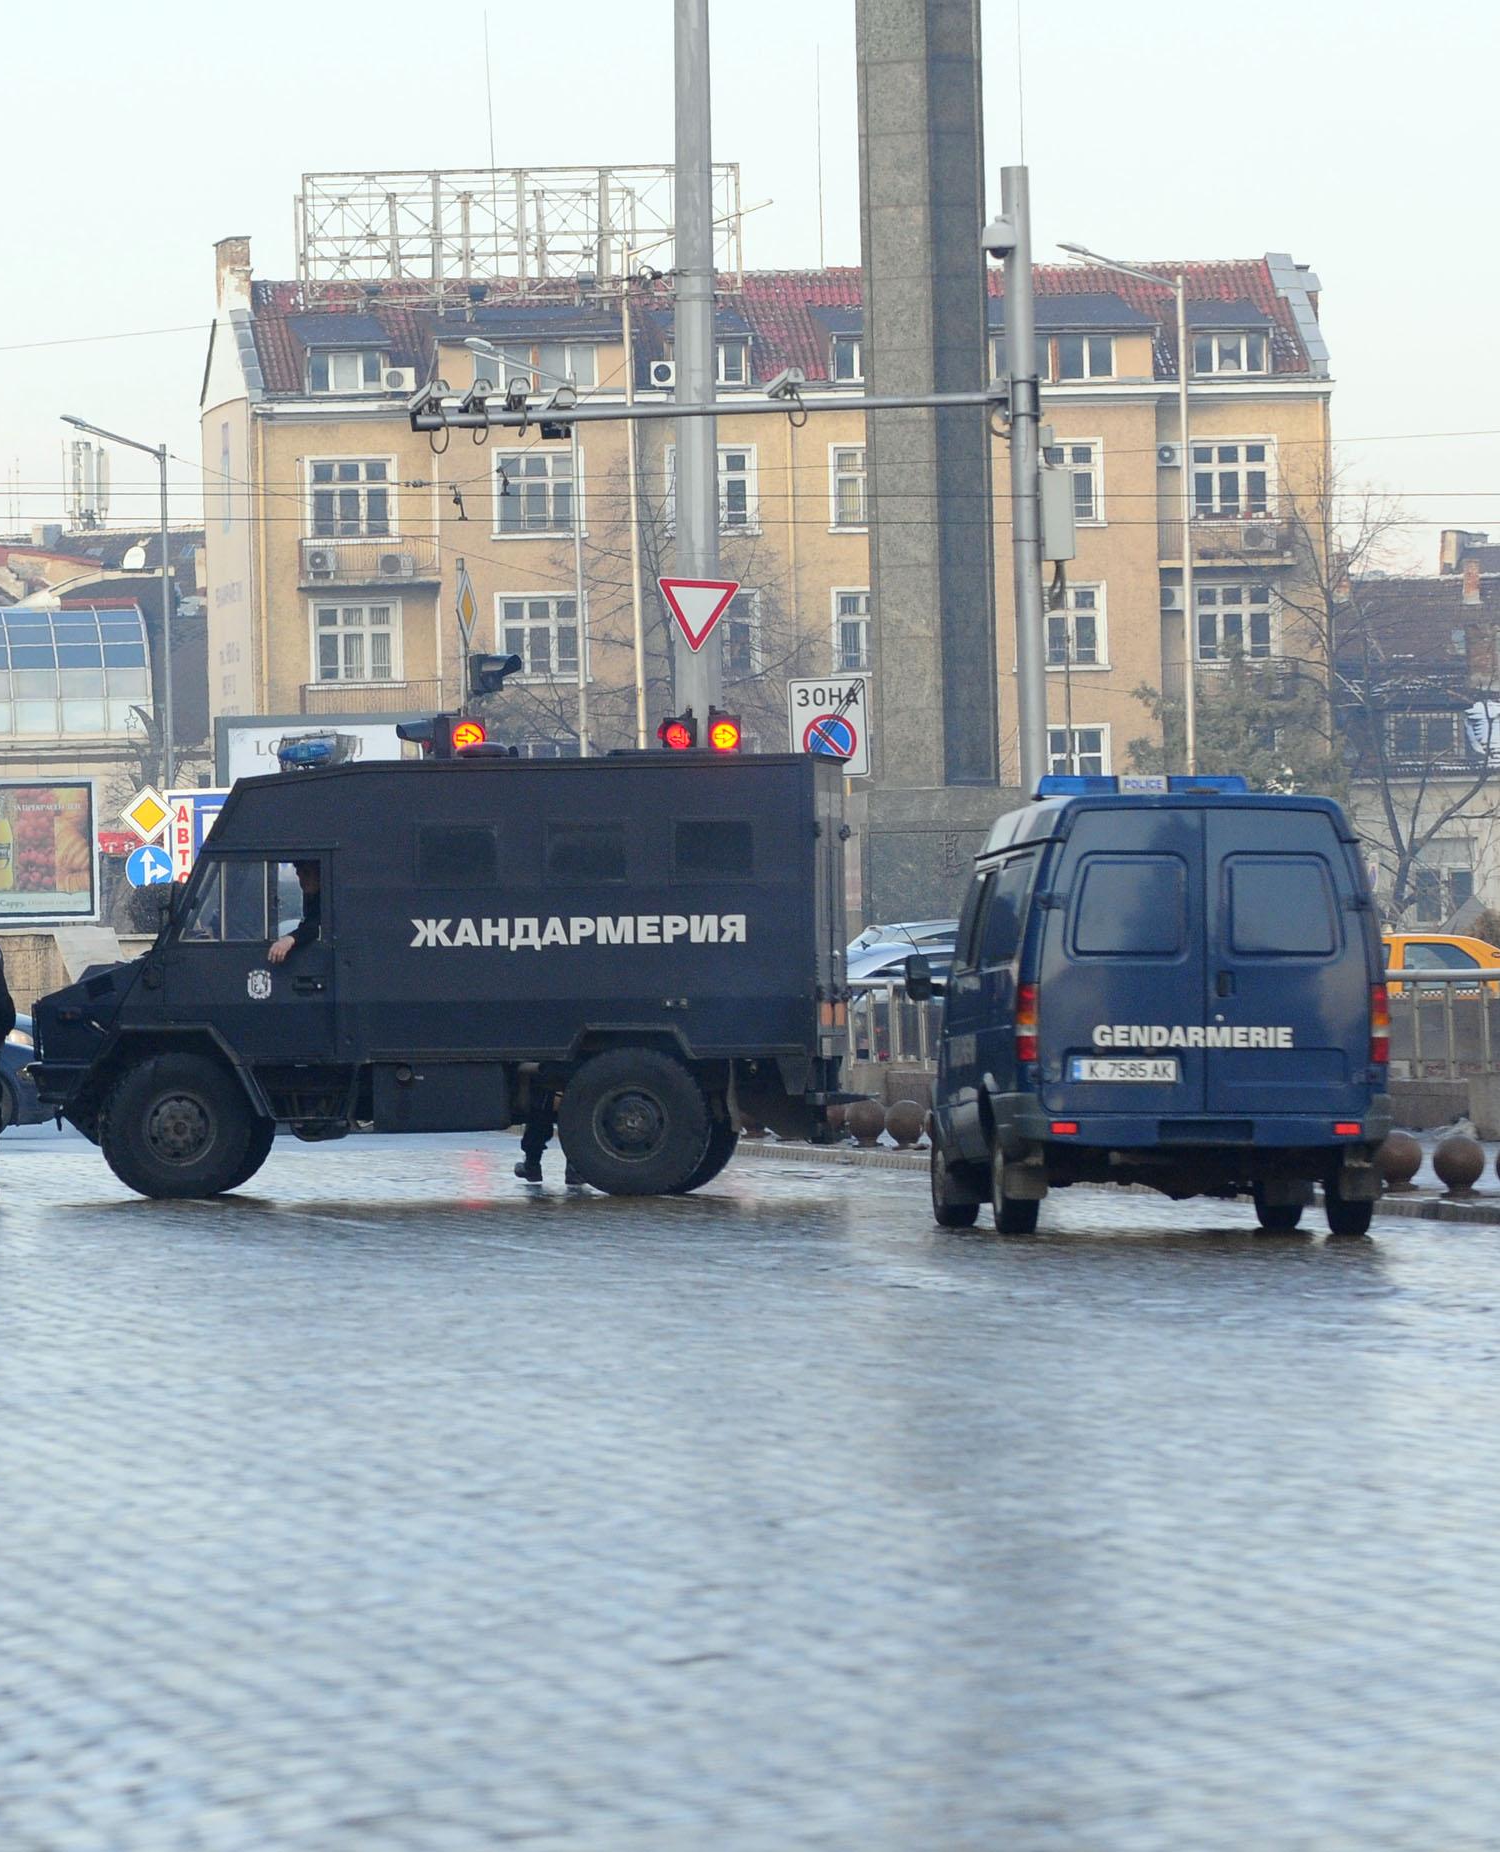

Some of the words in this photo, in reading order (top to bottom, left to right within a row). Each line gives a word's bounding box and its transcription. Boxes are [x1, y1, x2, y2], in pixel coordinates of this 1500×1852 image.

[797, 687, 859, 707] ЗОНА
[1123, 779, 1164, 789] POLICE
[411, 914, 747, 951] ЖАНДАРМЕРИЯ
[1093, 1025, 1293, 1048] GENDARMERIE
[1088, 1063, 1099, 1078] K
[1151, 1062, 1172, 1078] AK
